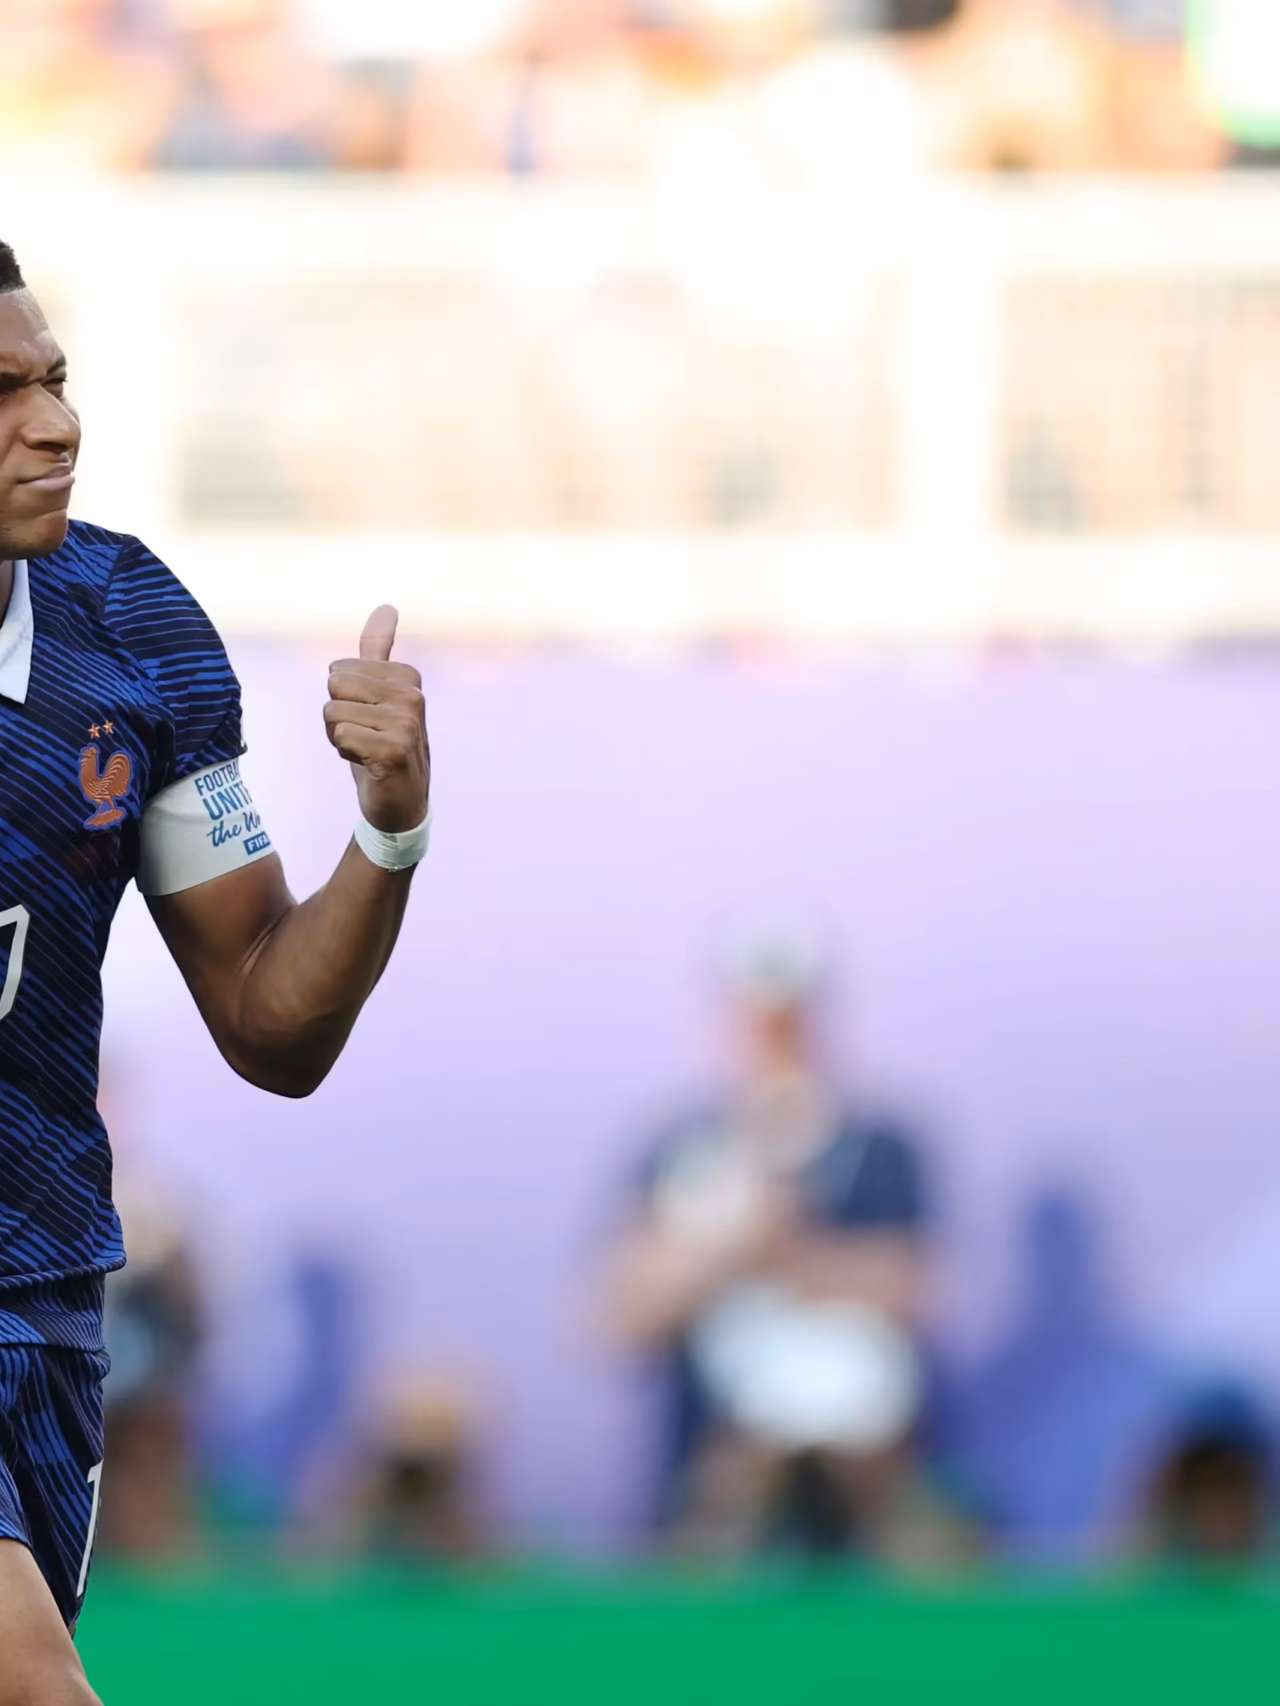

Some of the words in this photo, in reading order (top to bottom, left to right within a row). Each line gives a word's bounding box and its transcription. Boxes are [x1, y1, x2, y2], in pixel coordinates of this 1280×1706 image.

[194, 759, 240, 796] FOOTBA
[207, 820, 242, 847] the
[77, 1458, 104, 1597] 1
